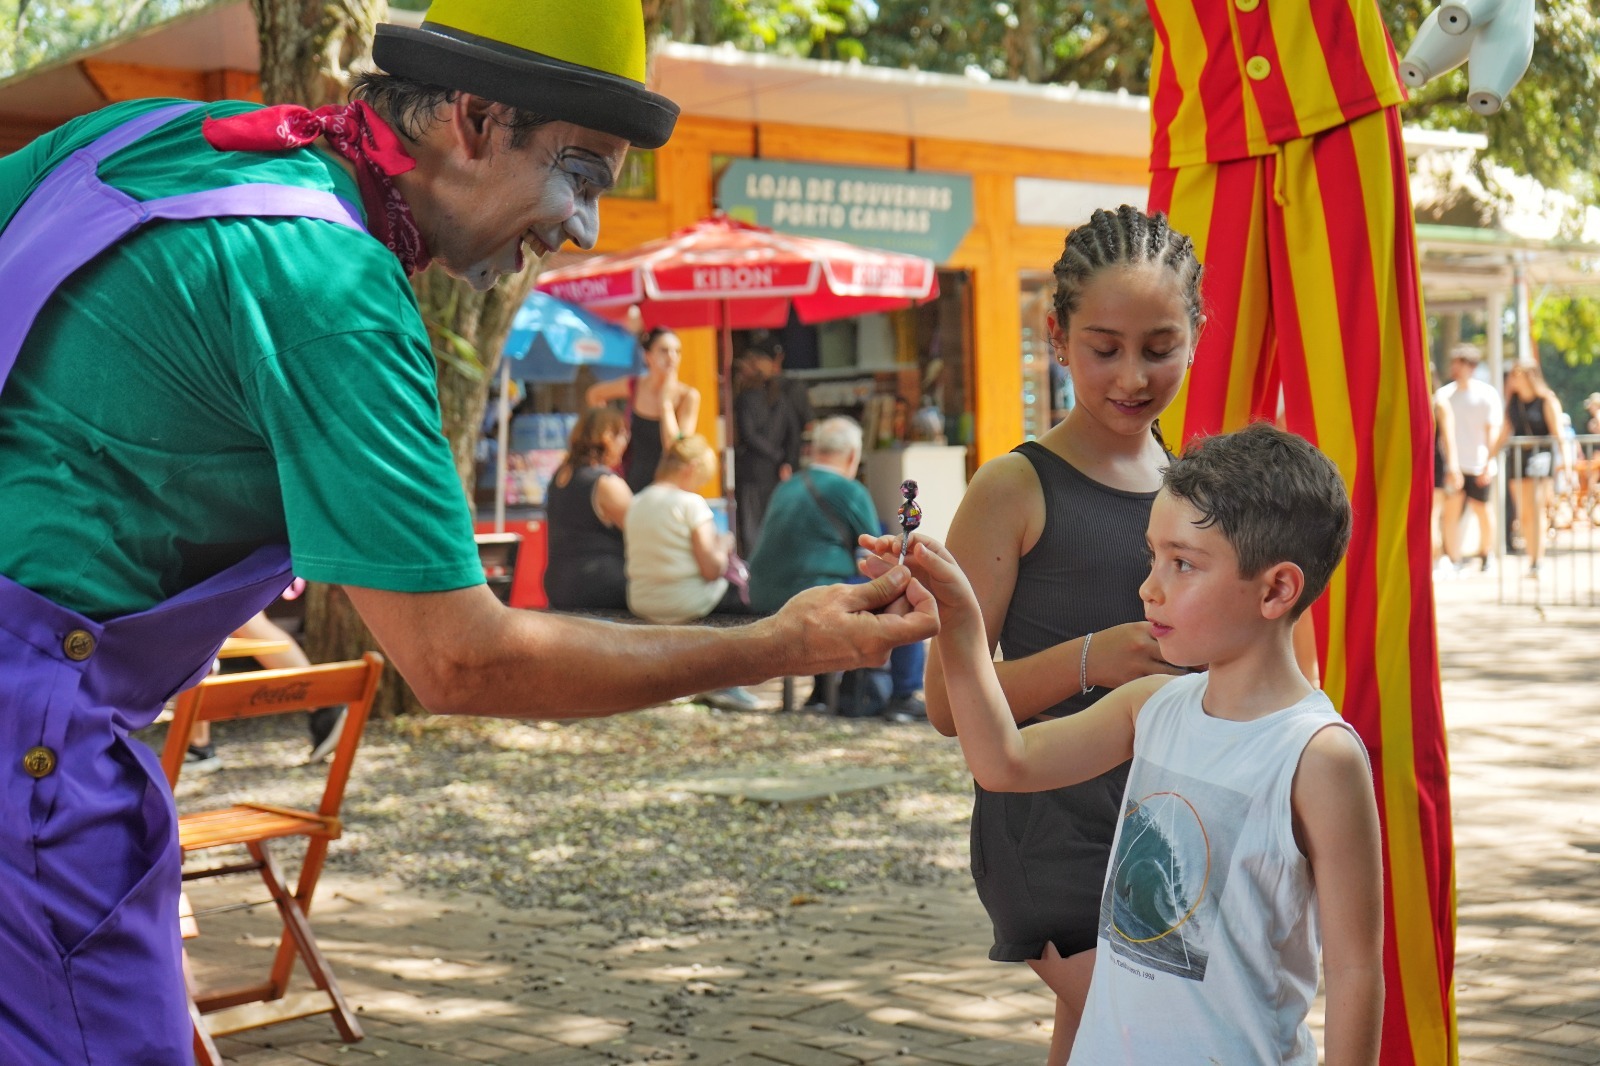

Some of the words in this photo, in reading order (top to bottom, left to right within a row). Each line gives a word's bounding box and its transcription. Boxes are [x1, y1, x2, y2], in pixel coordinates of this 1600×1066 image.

[746, 173, 802, 200] LOJA
[805, 177, 834, 202] DE
[838, 180, 952, 211] SOUVENIRS
[773, 200, 845, 229] PORTO
[693, 267, 774, 290] KIBON
